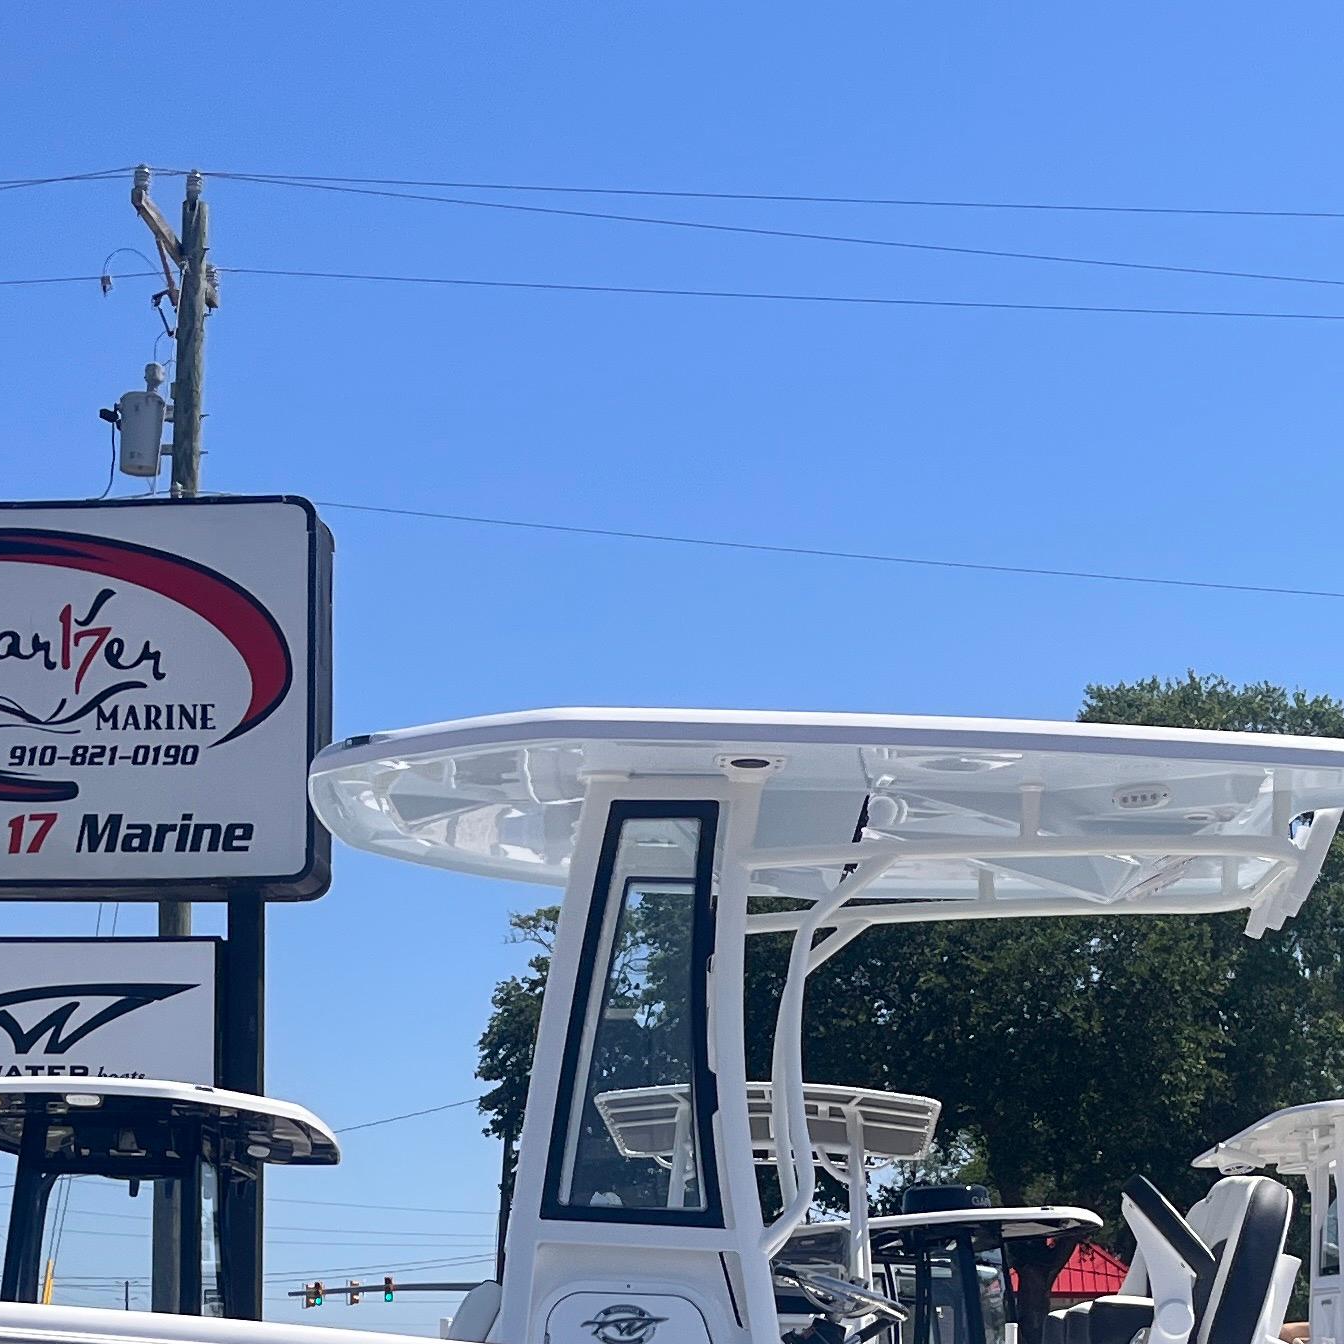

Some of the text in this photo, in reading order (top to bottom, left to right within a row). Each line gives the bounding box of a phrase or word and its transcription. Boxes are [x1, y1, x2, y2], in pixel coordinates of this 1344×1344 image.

[95, 703, 217, 732] MARINE
[8, 744, 200, 767] 910-821-0190
[8, 813, 58, 855] 17
[75, 813, 254, 855] Marine
